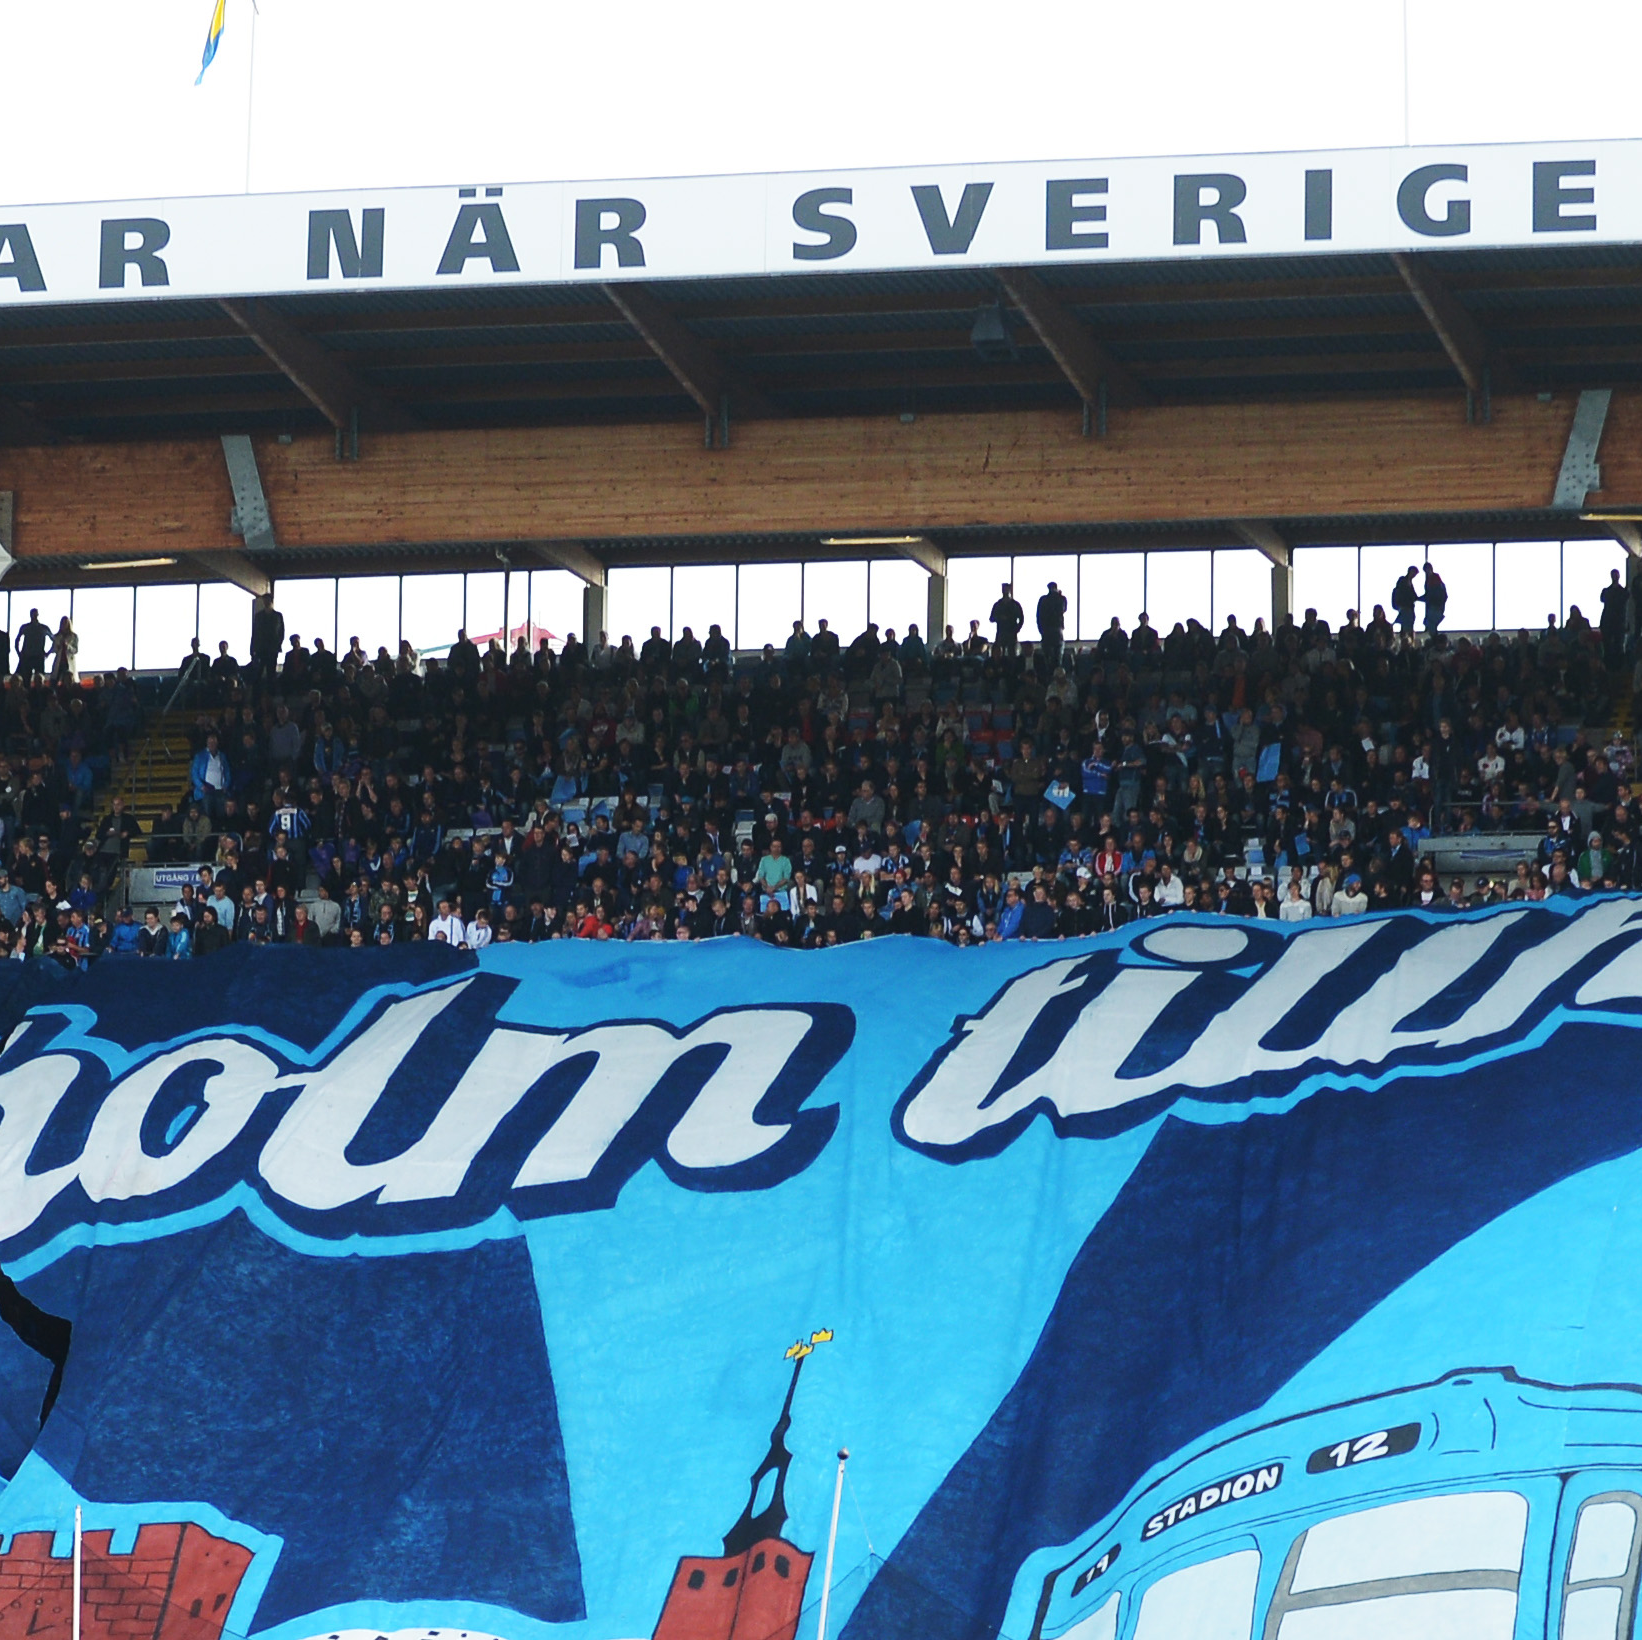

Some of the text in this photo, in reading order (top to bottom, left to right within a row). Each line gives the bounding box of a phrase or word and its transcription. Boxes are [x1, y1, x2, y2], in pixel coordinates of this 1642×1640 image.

[306, 187, 648, 281] NÄR
[791, 158, 1598, 262] SVERIGE
[1329, 1431, 1390, 1468] 12
[1145, 1465, 1280, 1539] STADION
